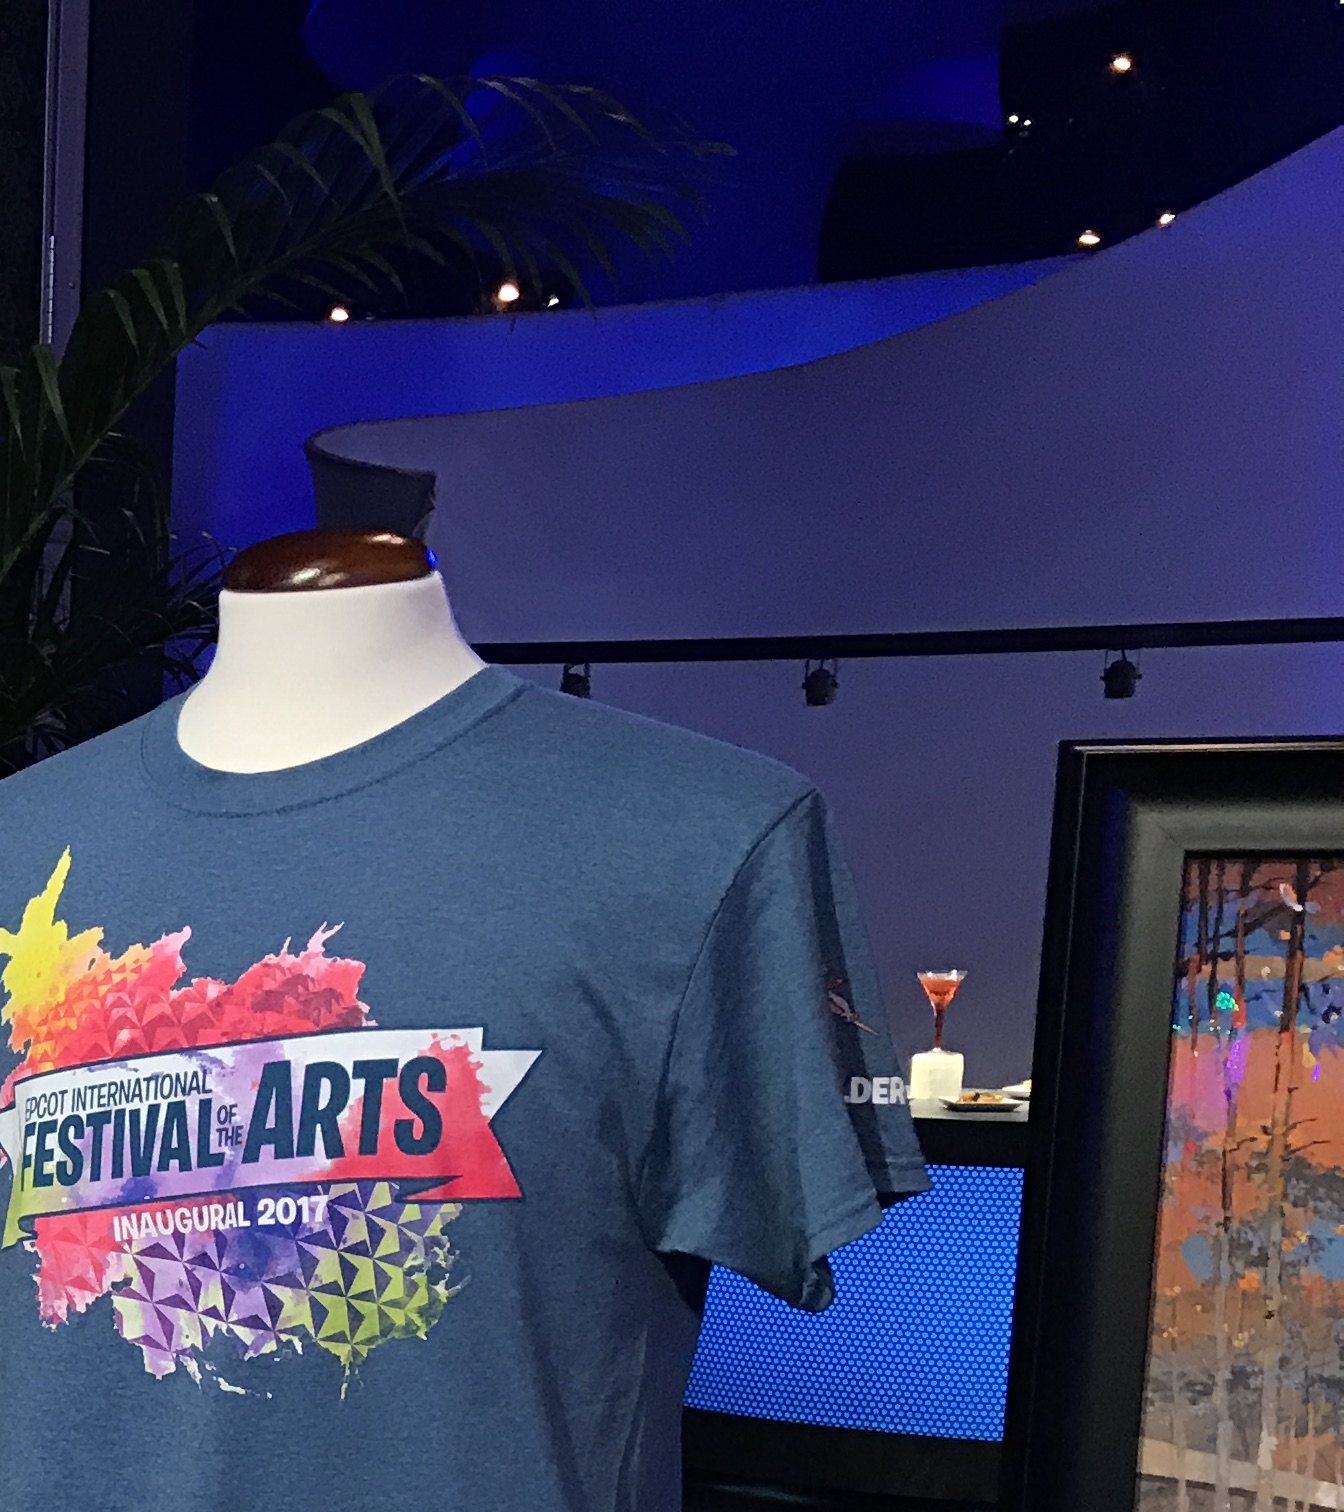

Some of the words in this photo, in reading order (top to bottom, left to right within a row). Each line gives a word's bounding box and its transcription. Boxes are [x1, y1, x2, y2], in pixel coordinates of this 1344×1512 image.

[24, 1085, 68, 1122] EPCOT
[70, 1069, 212, 1108] INTERNATIONAL
[217, 1103, 237, 1126] OF
[241, 1056, 447, 1165] ARTS
[843, 1076, 907, 1105] DER
[21, 1098, 225, 1192] FESTIVAL
[216, 1124, 244, 1148] THE
[112, 1202, 251, 1242] INAUGURAL
[256, 1194, 329, 1226] 2017
